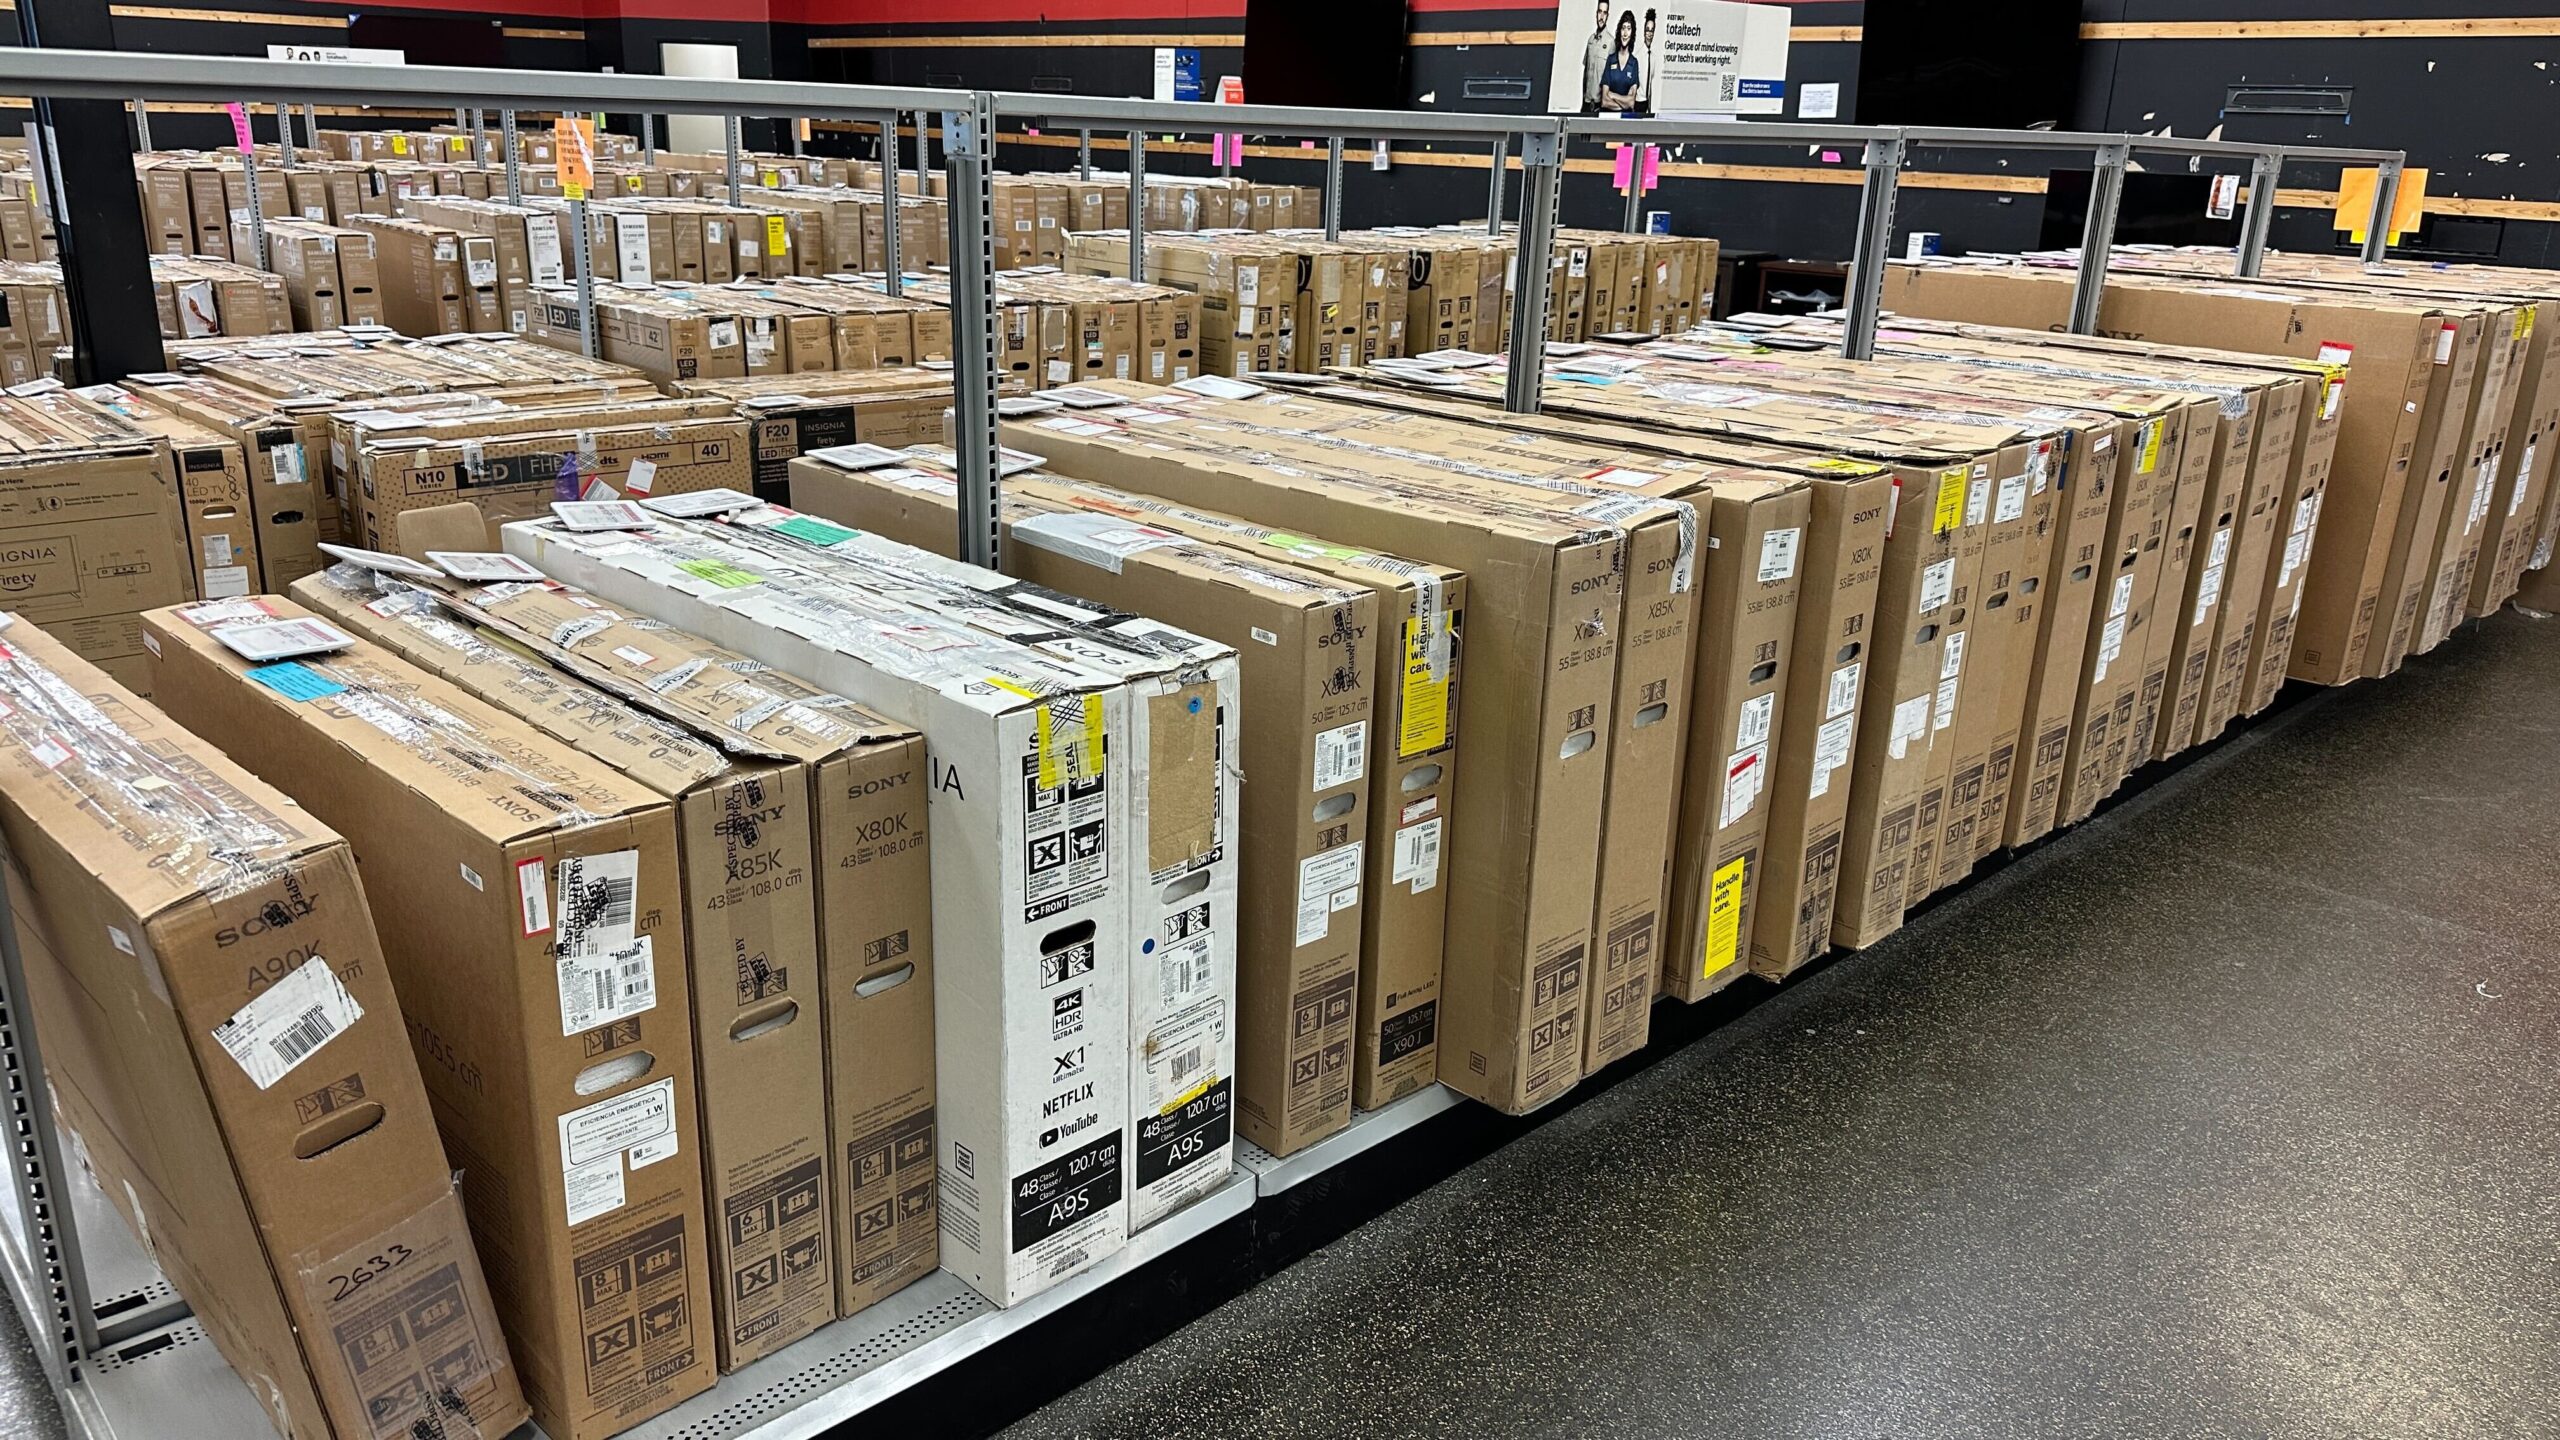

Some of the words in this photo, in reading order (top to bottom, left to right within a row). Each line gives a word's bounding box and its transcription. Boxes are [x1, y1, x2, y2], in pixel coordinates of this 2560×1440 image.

[1666, 23, 1701, 36] totaltech
[1664, 40, 1676, 50] Get
[1676, 42, 1694, 52] peace
[1694, 42, 1701, 51] of
[1701, 43, 1718, 52] mind
[1716, 44, 1738, 56] knowing
[1664, 54, 1678, 63] your
[1678, 54, 1694, 63] tech's
[1694, 56, 1717, 66] working
[1718, 56, 1732, 66] right.
[534, 306, 544, 318] F20
[552, 309, 566, 325] LED
[680, 346, 692, 355] F20
[680, 360, 694, 368] LED
[766, 424, 790, 438] F20
[804, 422, 846, 432] INSIGNIA
[2195, 426, 2213, 438] SONY
[760, 450, 778, 459] LED
[780, 446, 797, 457] FHD
[188, 462, 221, 470] INSIGNIA
[415, 468, 446, 484] N10
[467, 464, 509, 484] LED
[600, 456, 618, 465] dts
[640, 451, 671, 460] HDMI
[186, 478, 199, 487] 40
[187, 486, 208, 498] LED
[210, 485, 226, 494] TV
[420, 482, 443, 490] SERIES
[1852, 506, 1882, 524] SONY
[0, 547, 57, 563] IGNIA
[1850, 546, 1874, 566] X80K
[1646, 556, 1676, 574] SON
[1570, 574, 1612, 595] SONY
[1838, 577, 1848, 590] 55
[1648, 598, 1676, 620] X85K
[1746, 602, 1756, 614] 55
[1766, 594, 1784, 610] 138.8
[1783, 592, 1795, 605] cm
[1318, 625, 1368, 650] SOY
[1632, 634, 1642, 648] 55
[1655, 626, 1672, 641] 138.8
[1672, 624, 1682, 637] cm
[1558, 658, 1570, 671] 55
[1584, 647, 1602, 662] 138.8
[1602, 644, 1614, 657] cm
[1312, 711, 1324, 725] 50
[1338, 703, 1357, 718] 125.7
[1356, 700, 1368, 713] cm
[1064, 742, 1077, 774] SEAL
[848, 772, 912, 800] SONY
[1038, 792, 1051, 802] MAX
[486, 795, 541, 824] SONY
[714, 805, 786, 838] SNY
[855, 812, 909, 846] X80K
[840, 856, 857, 870] 43
[878, 842, 906, 858] 108.0
[908, 835, 924, 848] cm
[725, 848, 784, 885] X85K
[1716, 872, 1740, 892] Handle
[707, 894, 726, 912] 43
[750, 877, 782, 898] 108.0
[785, 872, 803, 888] cm
[1714, 888, 1730, 905] with
[1040, 898, 1068, 916] FRONT
[1714, 899, 1731, 914] care.
[215, 892, 319, 948] SOY
[640, 916, 662, 931] cm
[340, 964, 364, 984] cm
[1423, 980, 1434, 990] LED
[1056, 996, 1080, 1010] 4K
[1055, 1010, 1082, 1030] HDR
[1214, 1020, 1223, 1030] W
[1384, 1024, 1394, 1036] 50
[1408, 1010, 1423, 1025] 125.7
[1424, 1008, 1433, 1018] cm
[1053, 1029, 1073, 1042] ULTRA
[1074, 1024, 1084, 1035] HD
[420, 1020, 456, 1073] 105.5
[460, 1065, 484, 1097] cm
[1052, 1066, 1085, 1084] Ultimate
[654, 1103, 664, 1113] W
[1042, 1081, 1094, 1119] NETFLIX
[1211, 1090, 1227, 1108] cm
[1214, 1103, 1228, 1112] diag.
[580, 1112, 616, 1128] EFICIENCIA
[616, 1096, 656, 1114] ENERGÉTICA
[1186, 1099, 1212, 1120] 120.7
[1060, 1112, 1098, 1140] YouTube
[1143, 1120, 1161, 1140] 48
[1160, 1130, 1176, 1142] Clase
[1098, 1143, 1116, 1165] cm
[1167, 1130, 1204, 1166] A9S
[863, 1156, 873, 1170] 6
[1068, 1150, 1098, 1176] 120.7
[1102, 1157, 1116, 1168] diag.
[864, 1170, 877, 1180] MAX
[1040, 1172, 1054, 1183] Class
[1019, 1177, 1039, 1199] 48
[1040, 1178, 1058, 1192] Classe
[1040, 1189, 1056, 1201] Clase
[1048, 1188, 1091, 1228] A9S
[742, 1212, 752, 1226] 6
[744, 1224, 758, 1236] MAX
[328, 1244, 413, 1302] 2633
[864, 1255, 892, 1277] FRONT
[595, 1272, 607, 1288] 8
[596, 1286, 613, 1298] MAX
[748, 1312, 778, 1337] FRONT
[648, 1360, 682, 1383] FRONT
